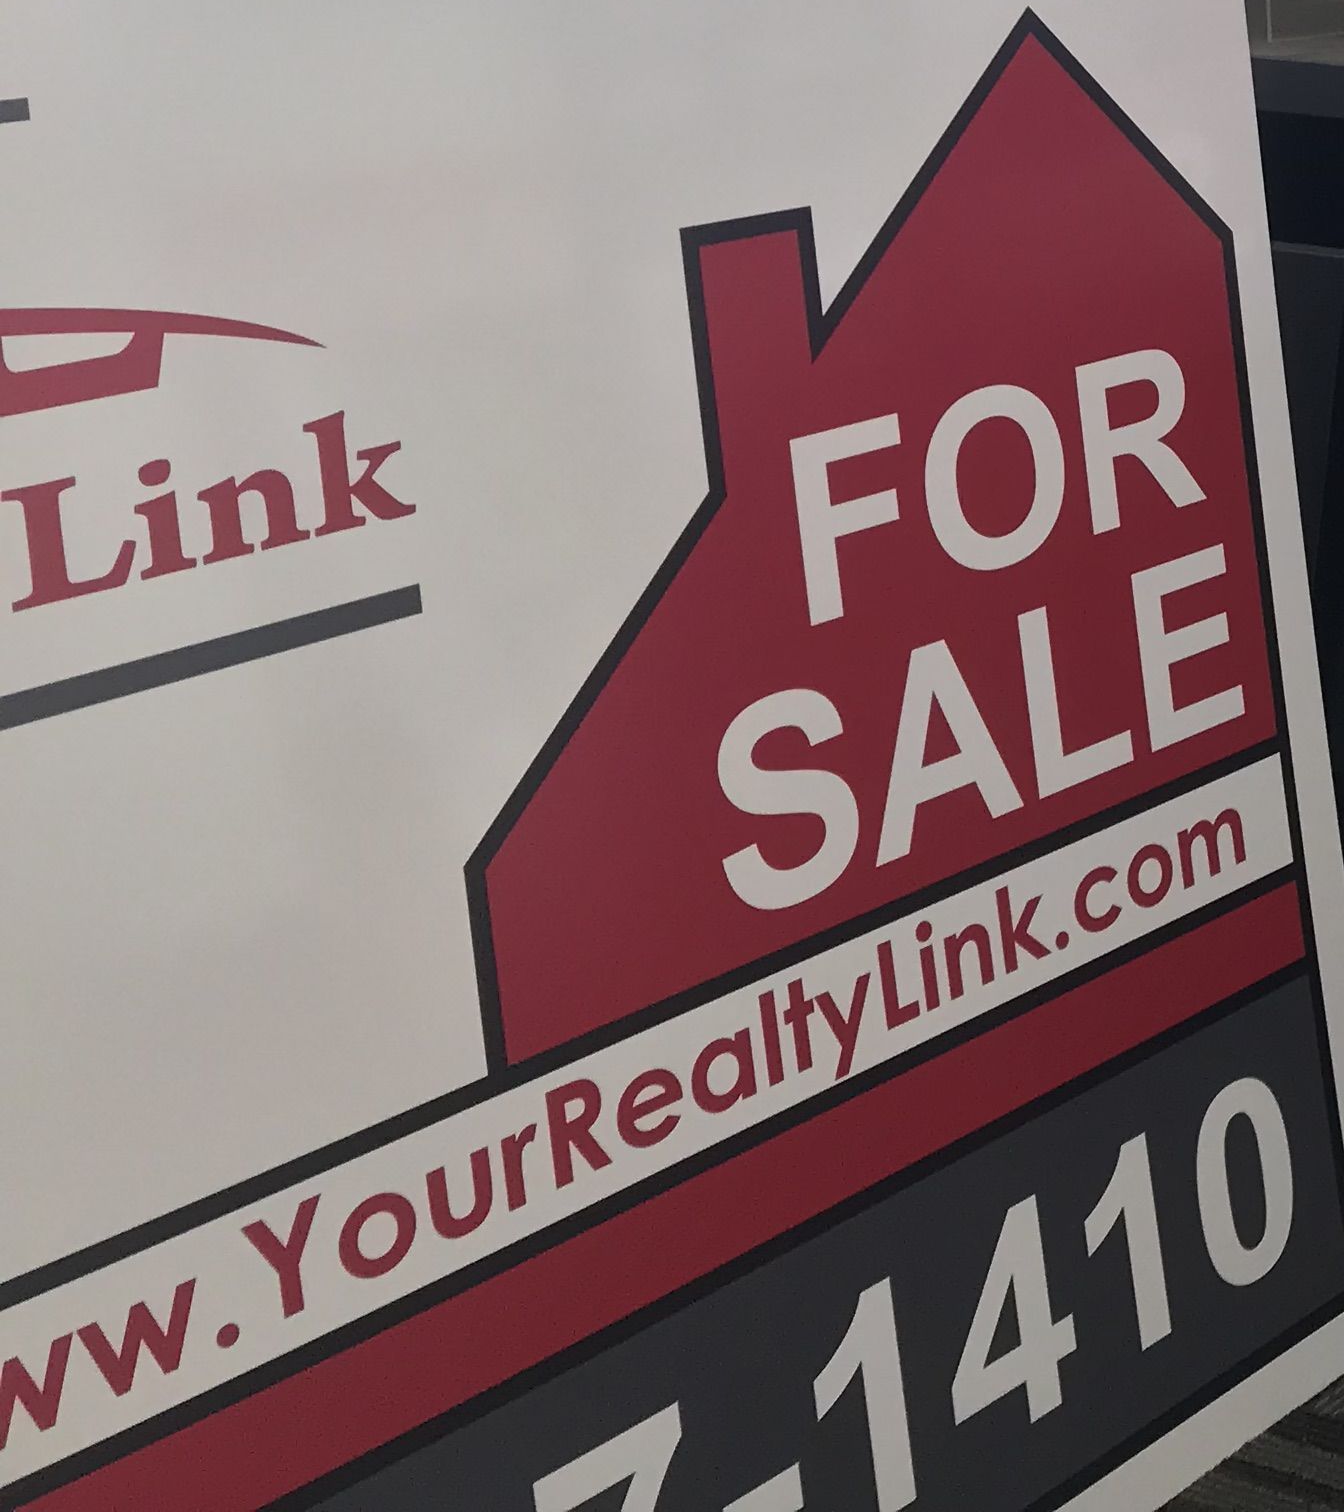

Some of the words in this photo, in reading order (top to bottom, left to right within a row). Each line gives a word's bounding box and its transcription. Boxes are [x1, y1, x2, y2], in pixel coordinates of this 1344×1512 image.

[1, 410, 416, 613] Link
[789, 349, 1207, 627] FOR
[717, 543, 1245, 910] SALE
